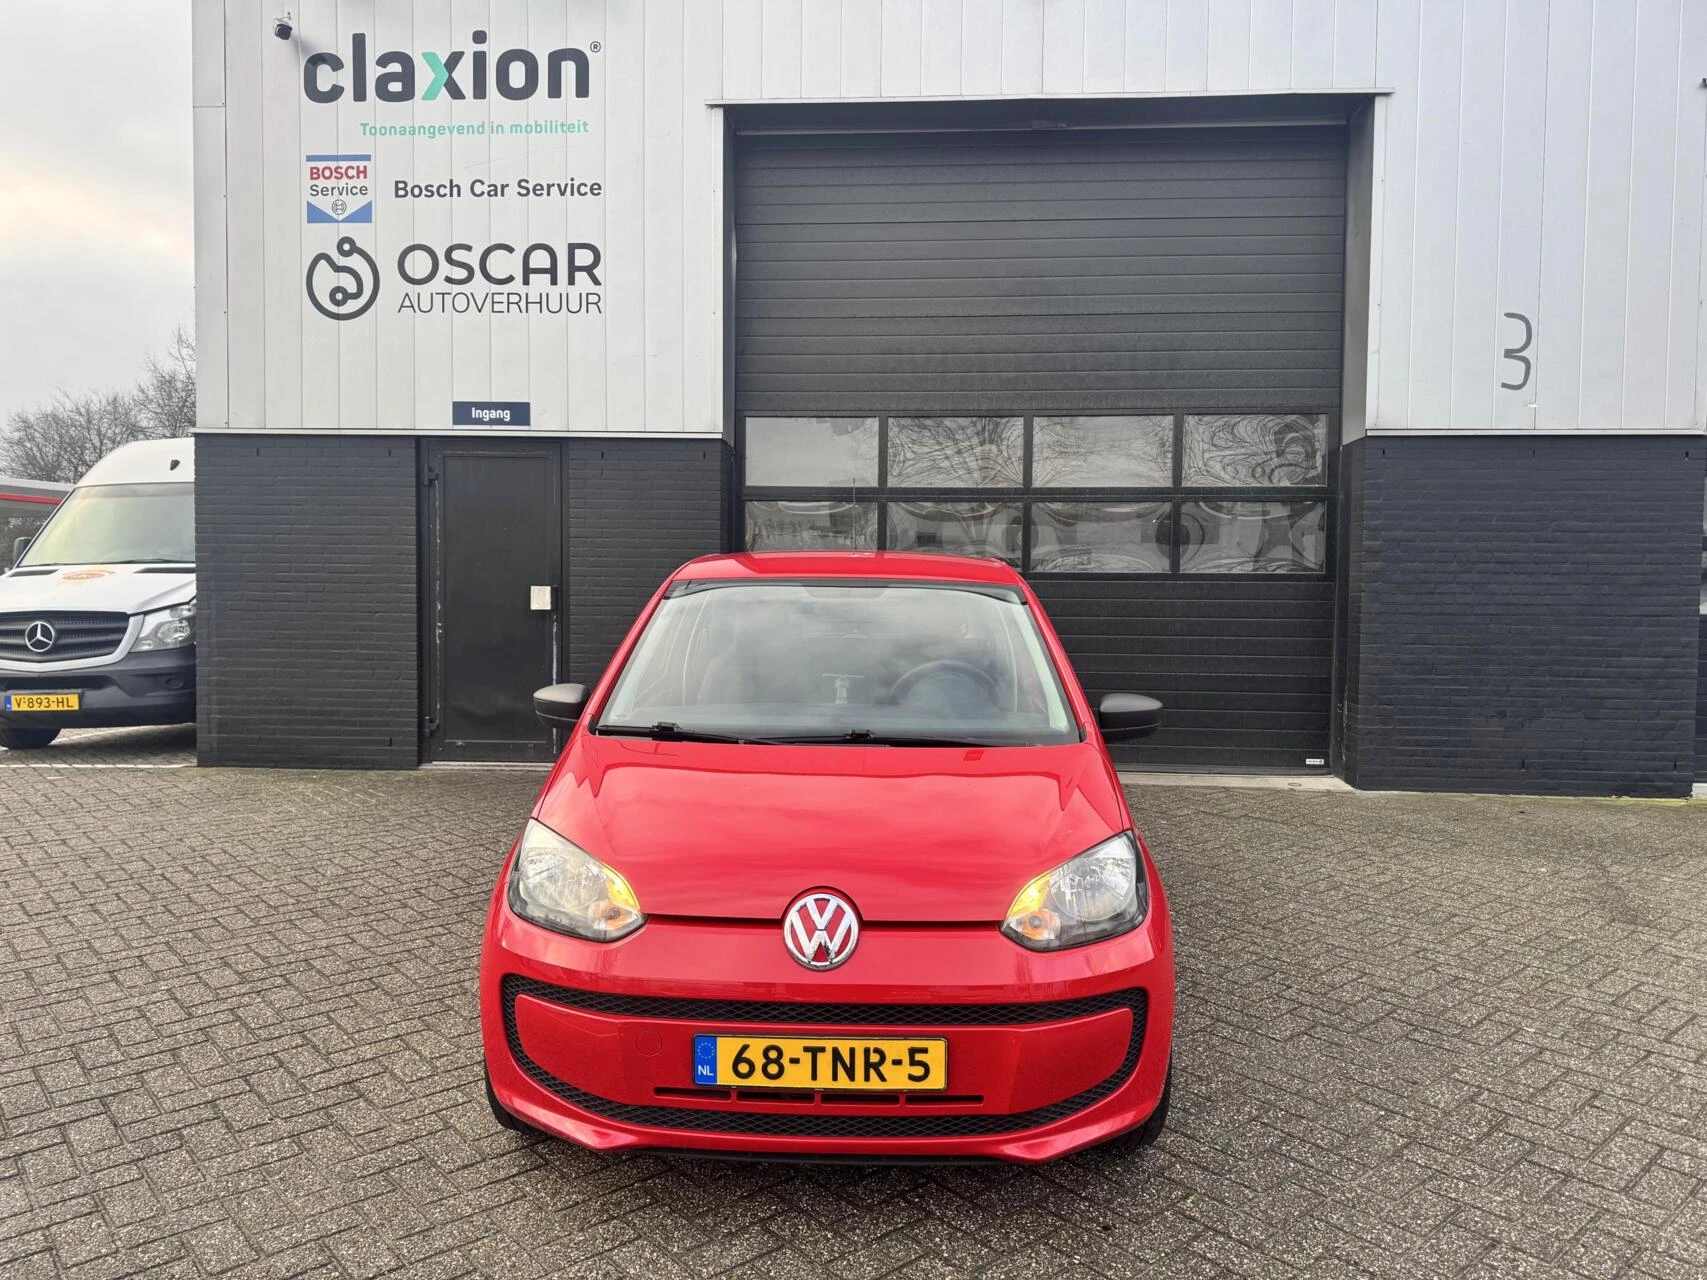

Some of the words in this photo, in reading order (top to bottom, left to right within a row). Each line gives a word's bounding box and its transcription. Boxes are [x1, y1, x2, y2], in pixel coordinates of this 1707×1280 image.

[360, 121, 485, 139] Toonaangevend
[490, 121, 504, 134] in
[509, 119, 589, 134] mobiliteit
[309, 165, 368, 181] BOSCH
[309, 182, 369, 197] Service
[394, 178, 462, 198] Bosch
[469, 178, 509, 197] Car
[516, 177, 602, 197] Service
[397, 242, 602, 286] OSCAR
[397, 291, 602, 314] AUTOVERHUUR
[1501, 312, 1533, 391] 3
[471, 406, 511, 422] Ingang
[697, 1065, 714, 1076] NL
[731, 1043, 931, 1083] 68-TNR-5
